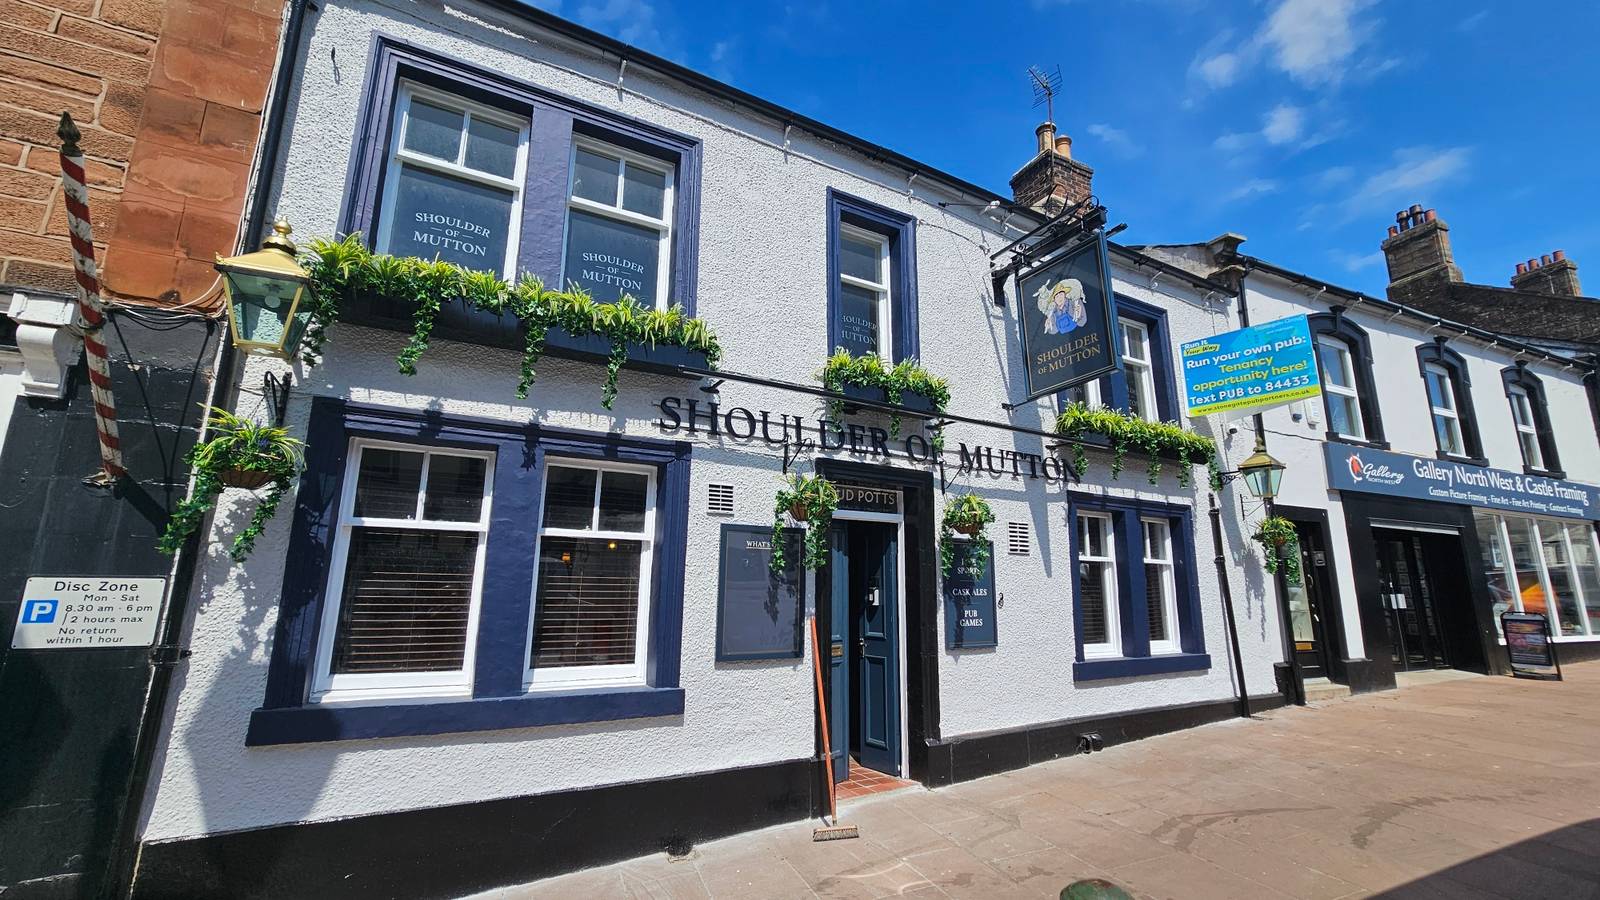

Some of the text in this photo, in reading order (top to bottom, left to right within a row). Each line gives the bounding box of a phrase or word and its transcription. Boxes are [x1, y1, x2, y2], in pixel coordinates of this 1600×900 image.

[415, 212, 491, 238] SHOULDER
[445, 229, 460, 237] OF
[413, 230, 487, 256] MUTTON
[582, 252, 644, 274] SHOULDER
[607, 266, 620, 274] OF
[582, 269, 642, 290] MUTTON
[841, 315, 877, 329] HOULDER
[1037, 333, 1099, 365] SHOULDER
[1186, 344, 1218, 355] Your Way
[1186, 335, 1307, 369] Run your own pub:
[1038, 344, 1101, 375] OF MUTTON
[1219, 356, 1274, 373] Tenancy
[1192, 360, 1308, 392] opportunity here!
[1190, 374, 1310, 405] Text PUB to 84433
[1197, 389, 1311, 413] www.stonegatepubpartners.co.uk
[660, 397, 891, 457] SHOULDER
[958, 442, 1080, 483] MUTTON
[1363, 463, 1405, 484] Gallery
[1413, 459, 1590, 506] Gallery North West & Castle Framing
[836, 489, 895, 504] UD POTTS
[1429, 486, 1449, 498] Custom
[1449, 489, 1467, 500] Picture
[1467, 491, 1488, 504] Framing
[1490, 494, 1501, 504] Fine
[1501, 496, 1509, 505] Art
[1512, 498, 1522, 506] Fine
[1522, 499, 1530, 508] Art
[1530, 500, 1547, 512] Printing
[1549, 502, 1567, 513] Contract
[1567, 505, 1584, 517] Framing
[746, 540, 771, 548] WHAT'S
[54, 581, 139, 592] Disc Zone
[952, 588, 988, 596] CASK ALES
[83, 594, 108, 602] Mon
[120, 594, 140, 602] Sat
[65, 604, 94, 612] 8.30
[136, 605, 153, 613] pm
[964, 609, 978, 618] PUB
[70, 616, 78, 624] 2
[960, 618, 983, 627] GAMES
[58, 627, 117, 635] No return
[46, 636, 82, 644] within
[88, 636, 93, 644] 1
